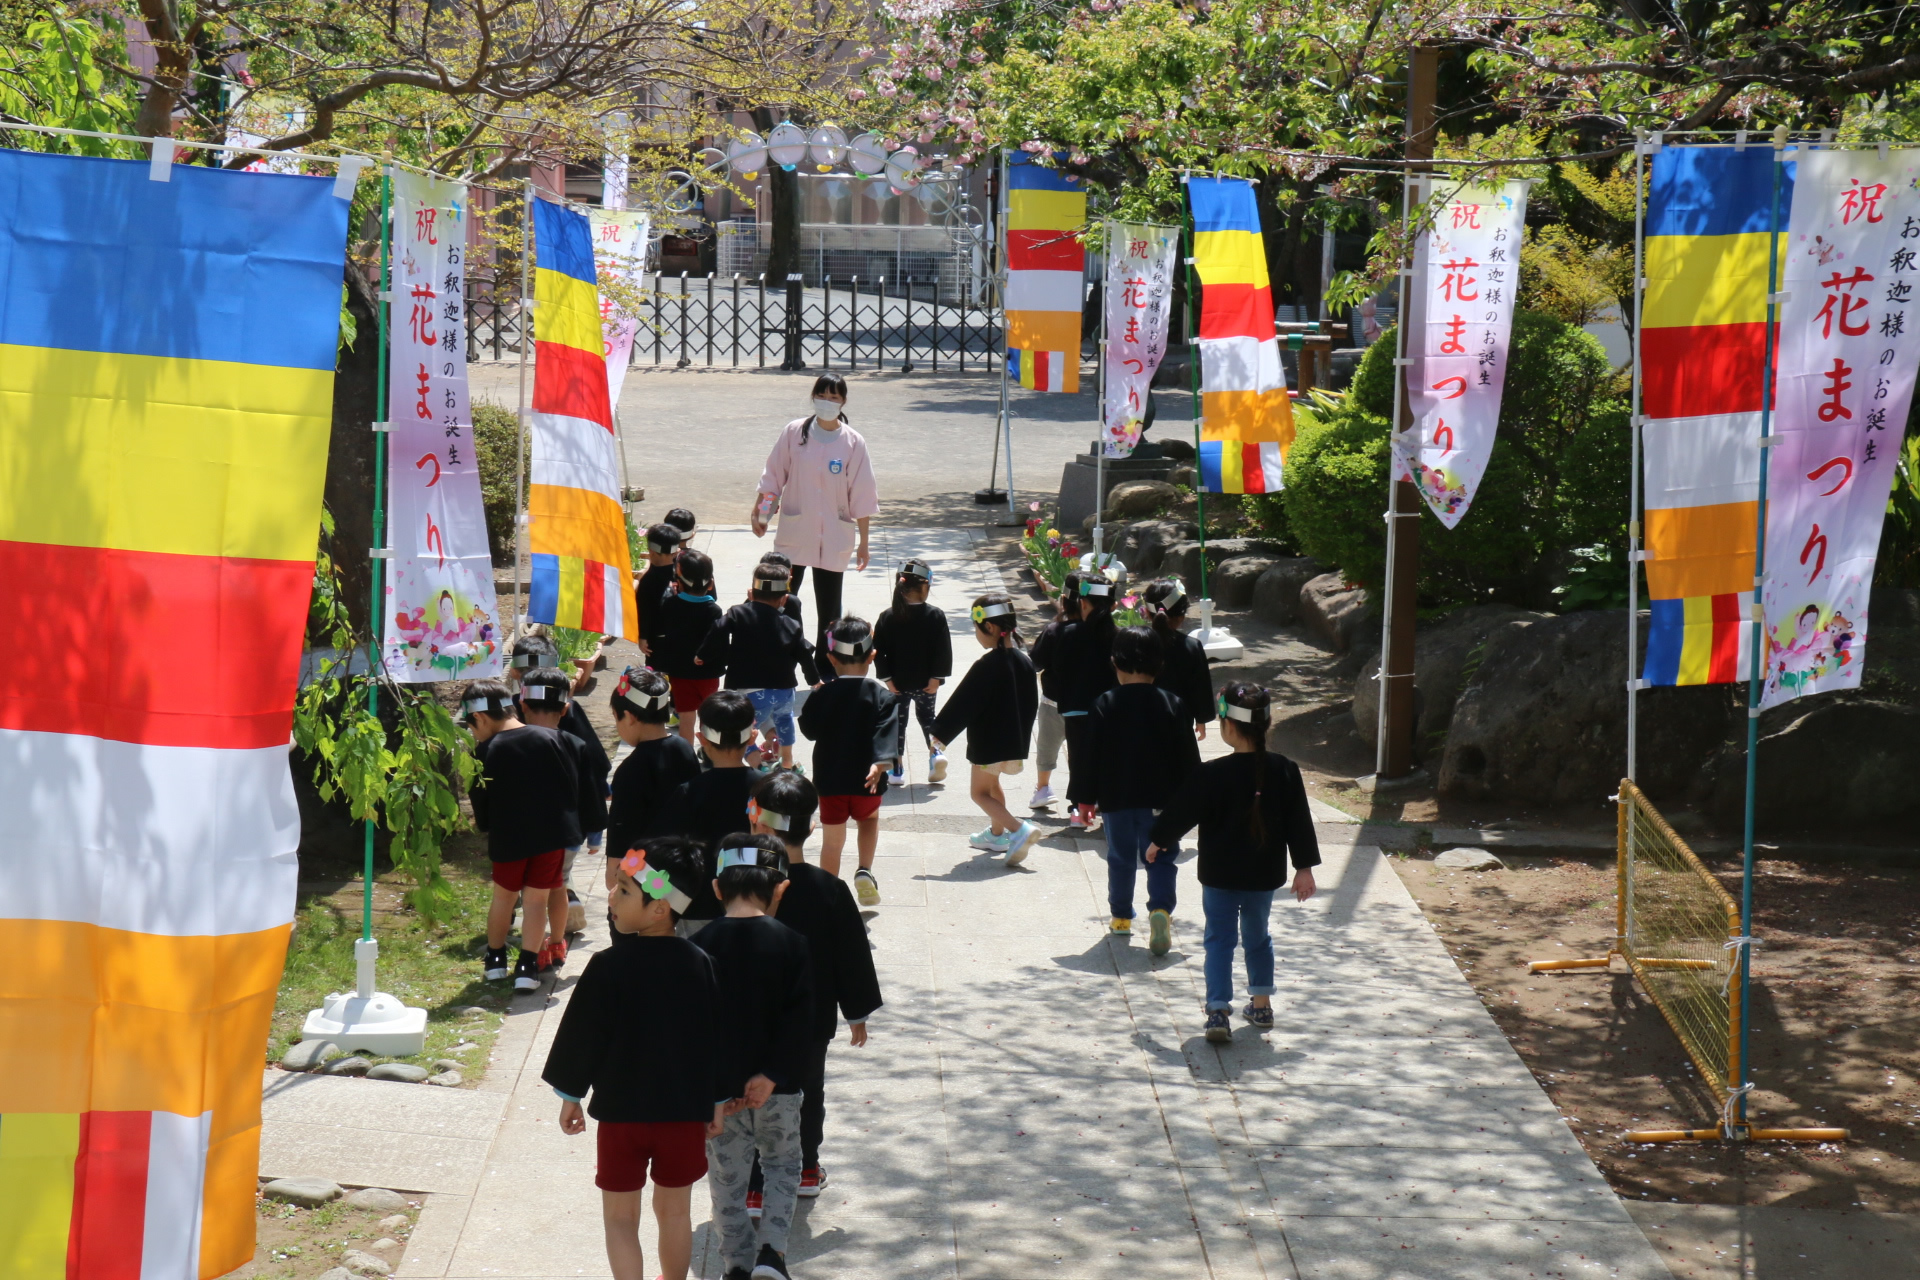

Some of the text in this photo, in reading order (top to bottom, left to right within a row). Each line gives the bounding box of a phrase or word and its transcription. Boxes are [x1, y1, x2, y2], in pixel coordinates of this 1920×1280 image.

[599, 221, 621, 243] 祝
[1477, 227, 1508, 386] お釈迦様のお誕生
[442, 244, 462, 466] お釈迦様のお誕生
[1146, 258, 1165, 368] お釈迦様のお誕生
[1862, 215, 1920, 465] お釈迦様のお誕生
